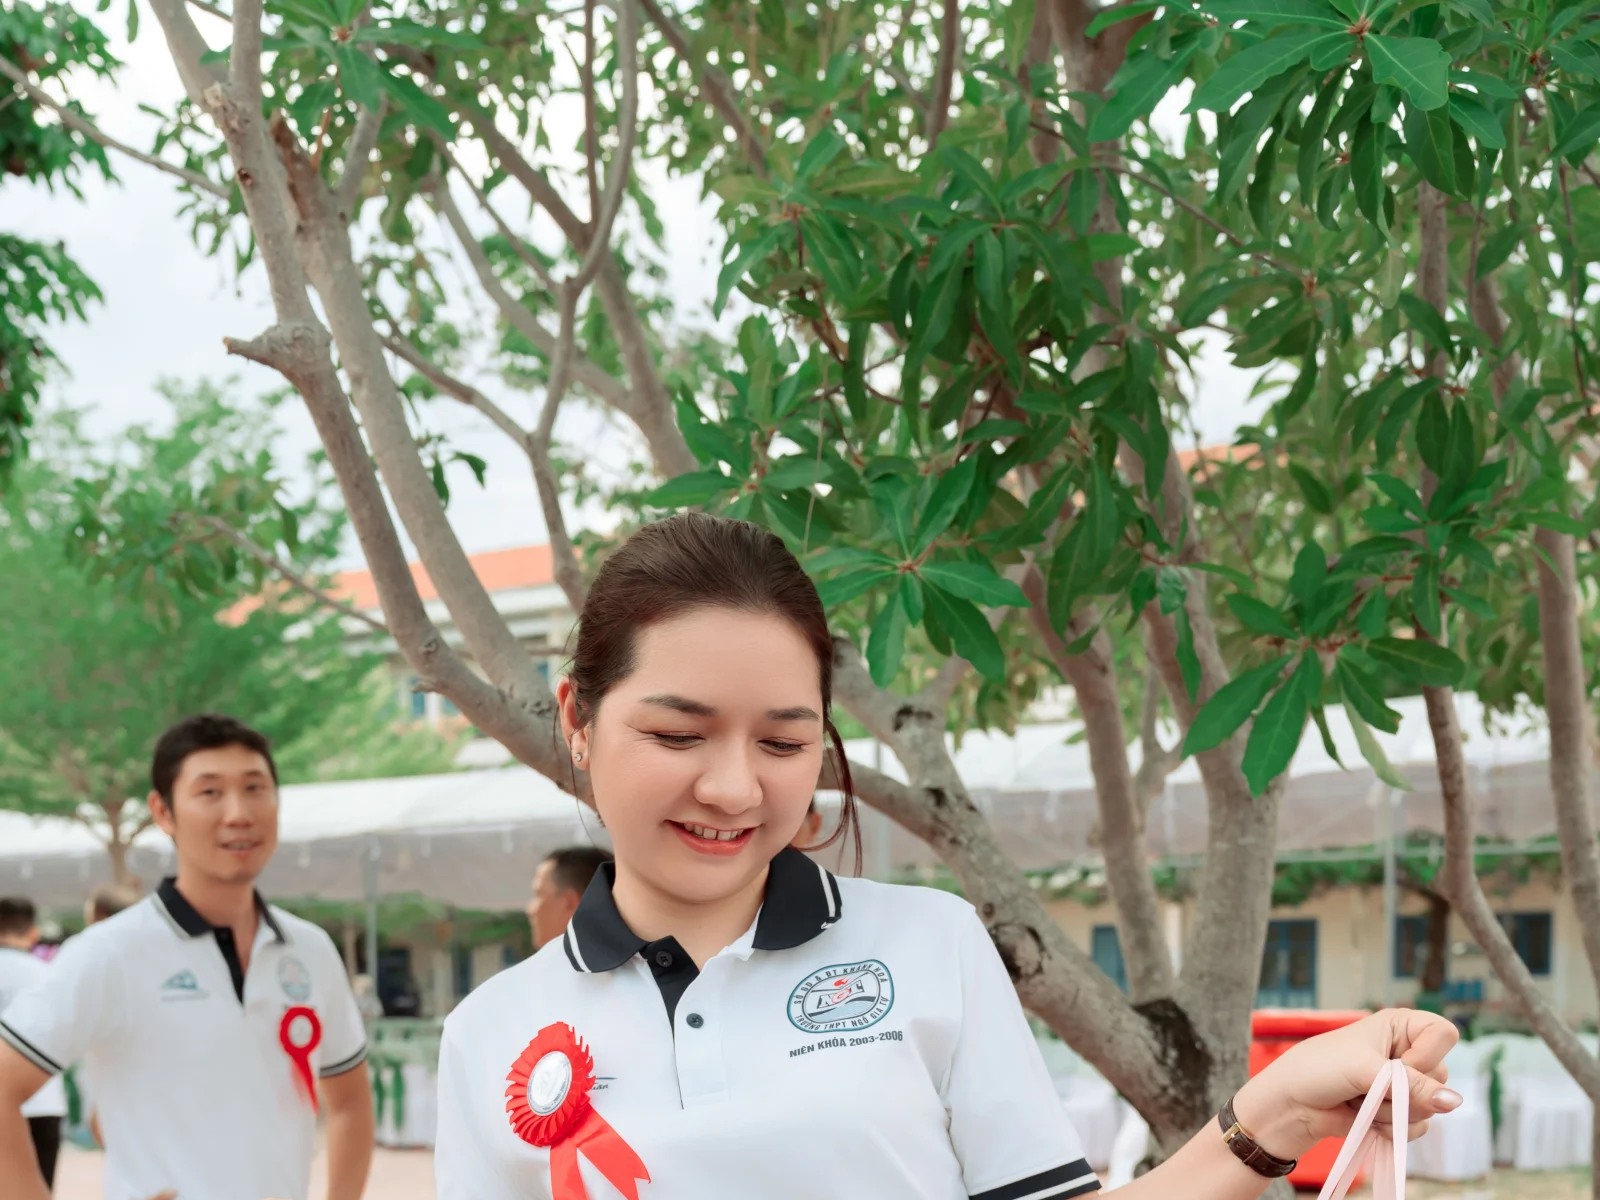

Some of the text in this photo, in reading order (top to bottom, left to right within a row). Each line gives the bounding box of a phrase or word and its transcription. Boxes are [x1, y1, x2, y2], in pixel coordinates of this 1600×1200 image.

[824, 1021, 846, 1029] THPT
[870, 1007, 884, 1019] GIA
[789, 1030, 903, 1058] NIÊN KHÓA 2003-2006
